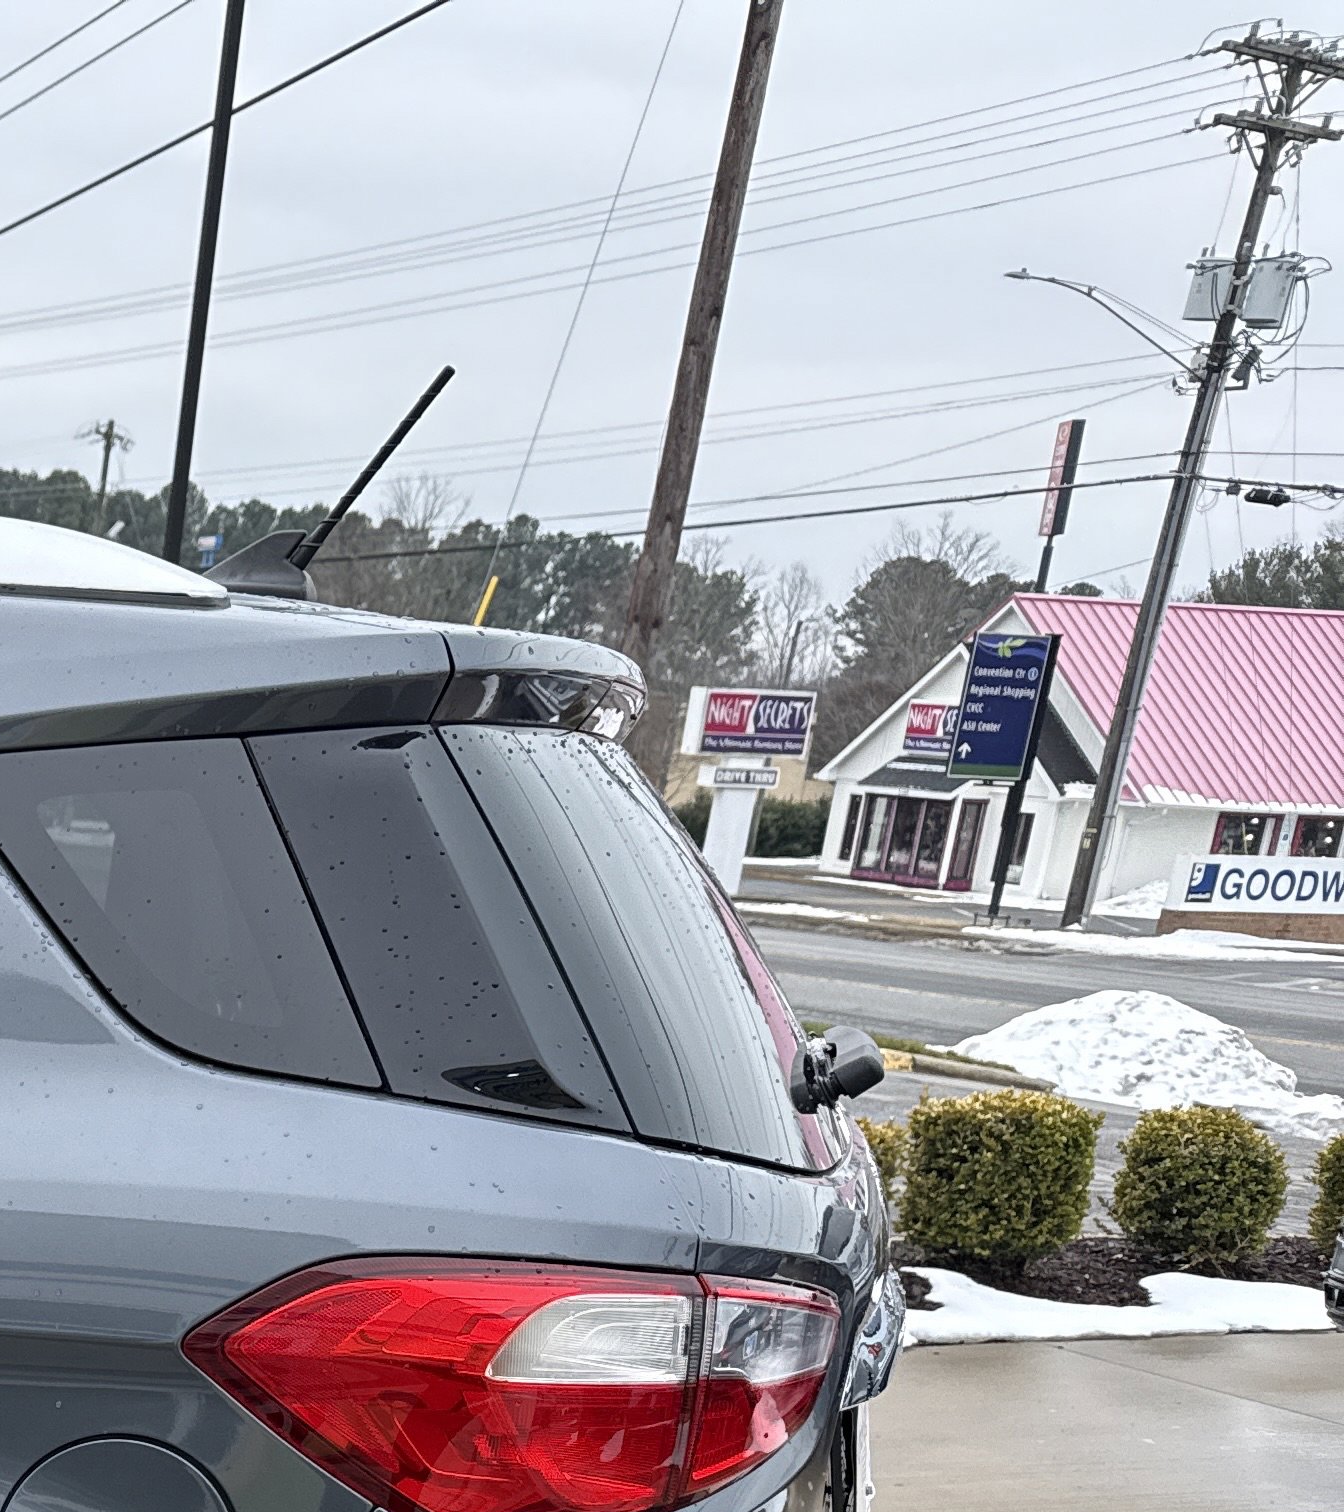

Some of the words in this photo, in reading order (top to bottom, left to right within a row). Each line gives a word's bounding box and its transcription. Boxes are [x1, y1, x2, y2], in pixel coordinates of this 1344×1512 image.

[974, 666, 1013, 678] Convention
[1015, 667, 1026, 679] Ctr
[969, 684, 1002, 697] Regional
[1002, 685, 1036, 700] Shopping
[757, 700, 812, 729] SECRETS
[977, 721, 1002, 733] Center
